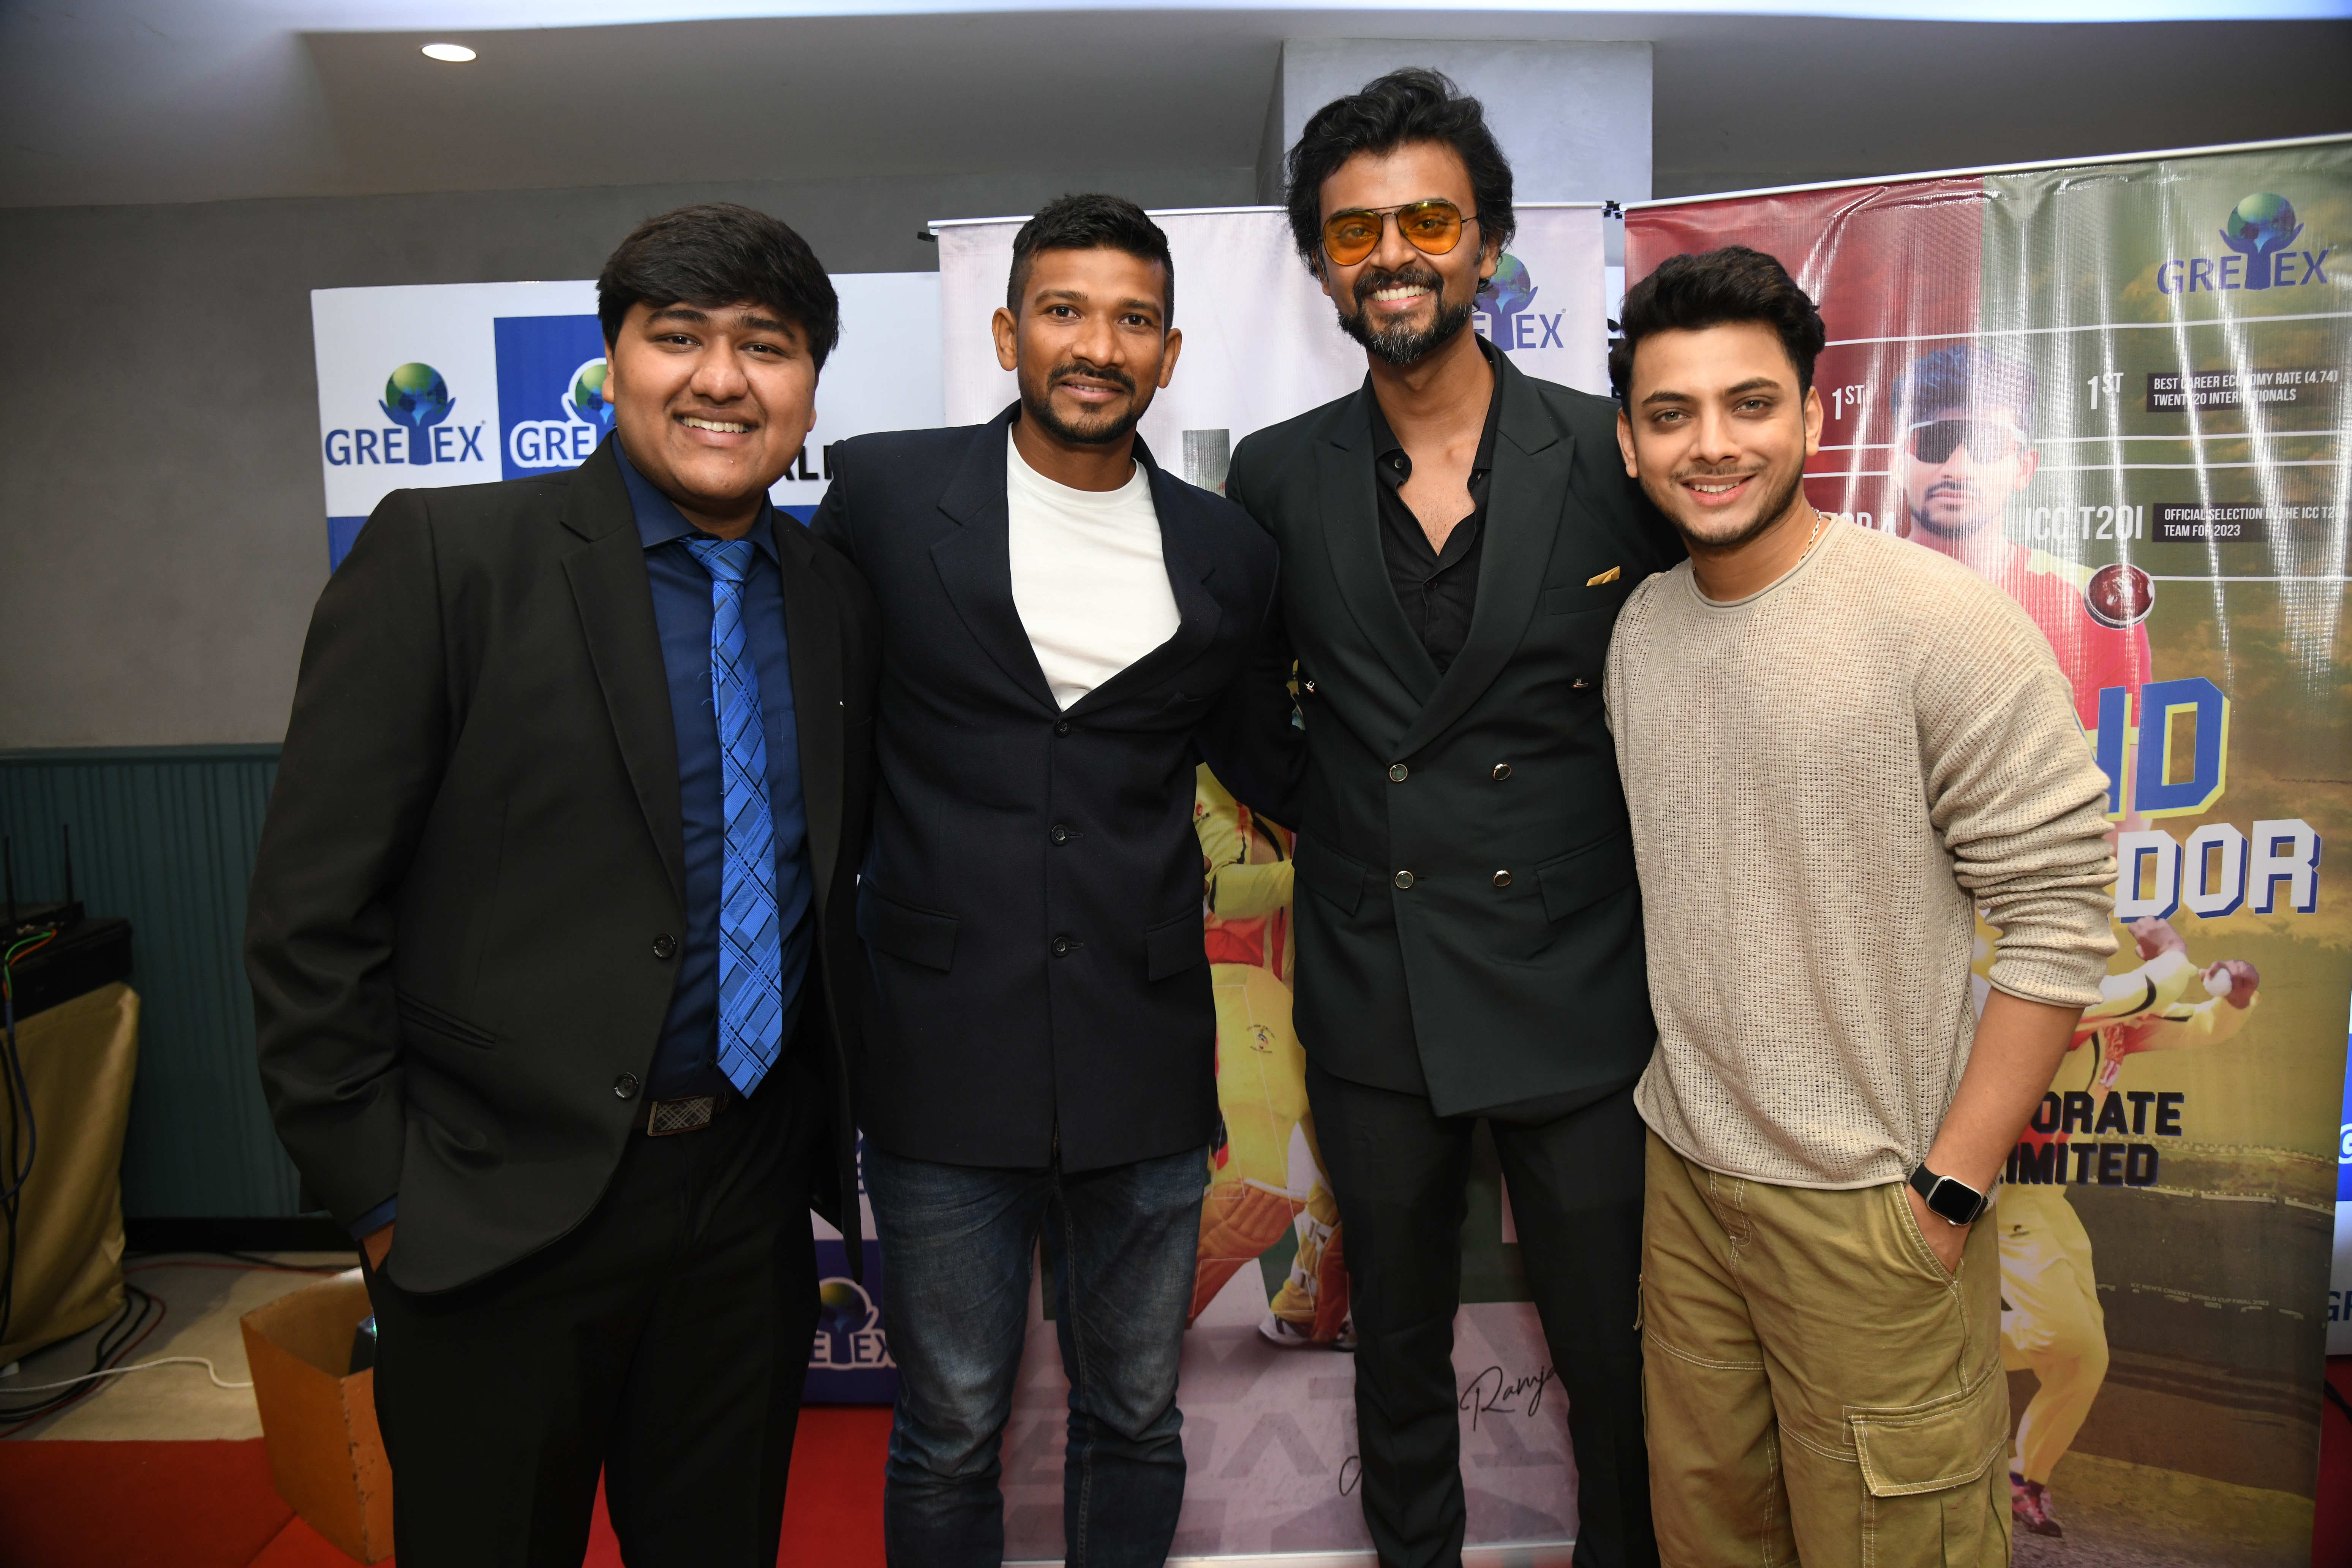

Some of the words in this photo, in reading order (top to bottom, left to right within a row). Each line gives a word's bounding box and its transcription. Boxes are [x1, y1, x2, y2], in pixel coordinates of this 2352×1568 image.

[2087, 372, 2124, 410] 1ST
[2154, 378, 2178, 390] BEST
[2181, 375, 2220, 390] CAREER
[2222, 372, 2273, 387] ECOOMY
[2275, 371, 2302, 384] RATE
[2304, 370, 2338, 384] (4.74)
[1832, 384, 1865, 420] 1ST
[2153, 392, 2207, 406] TWENT20
[2209, 388, 2297, 405] INTERNTIONALS
[2025, 506, 2071, 541] ICC
[2078, 505, 2143, 540] T20I
[2164, 508, 2206, 521] OFFICIAL
[2209, 508, 2263, 520] SELECTION
[2278, 507, 2298, 519] THE
[2301, 506, 2319, 519] ICC
[2164, 525, 2189, 537] TEAM
[2192, 524, 2211, 536] FOR
[2214, 524, 2241, 536] 2023
[2000, 1142, 2160, 1186] IMITED
